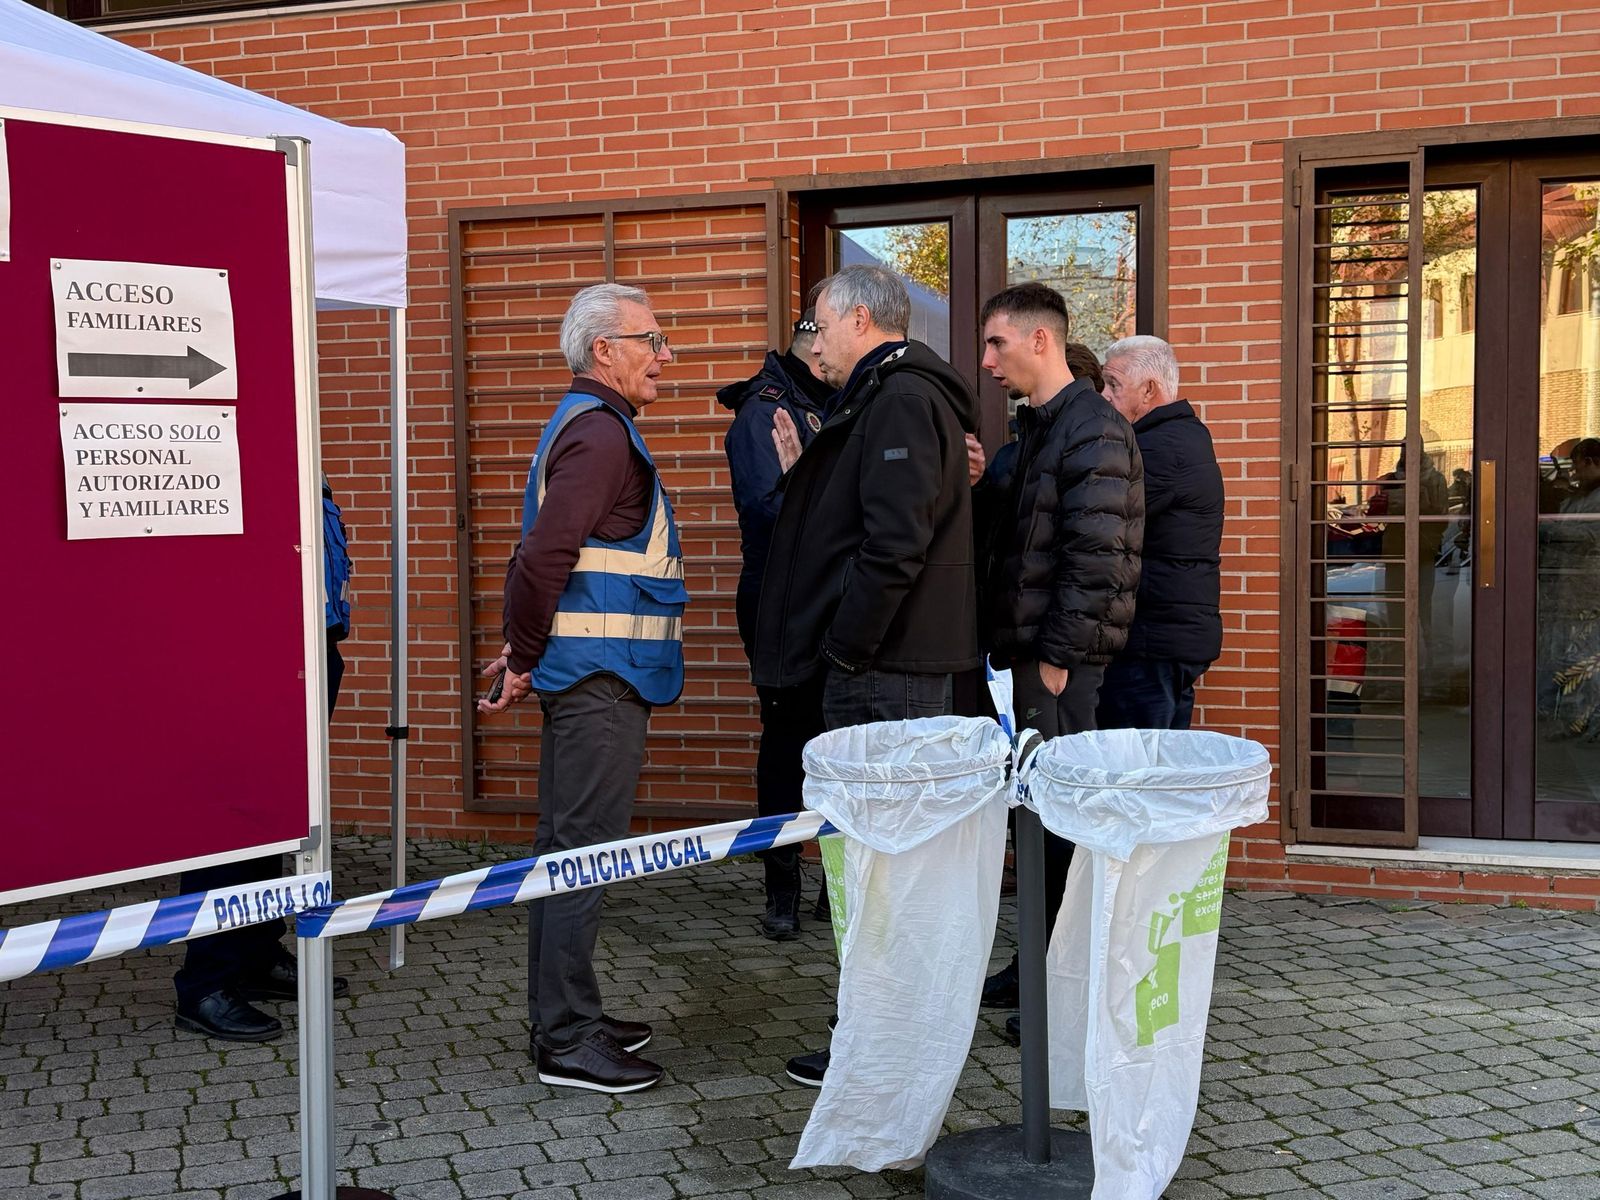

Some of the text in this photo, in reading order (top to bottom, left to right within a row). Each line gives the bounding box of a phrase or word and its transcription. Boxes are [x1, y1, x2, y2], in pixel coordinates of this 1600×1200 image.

[66, 281, 174, 305] ACCESO
[67, 311, 202, 333] FAMILIARES
[73, 423, 221, 442] ACCESO SOLO
[76, 449, 191, 466] PERSONAL
[77, 474, 221, 492] AUTORIZADO
[79, 499, 229, 518] Y FAMILIARES
[546, 835, 711, 891] POLICIA LOCAL
[213, 886, 296, 930] POLICIA
